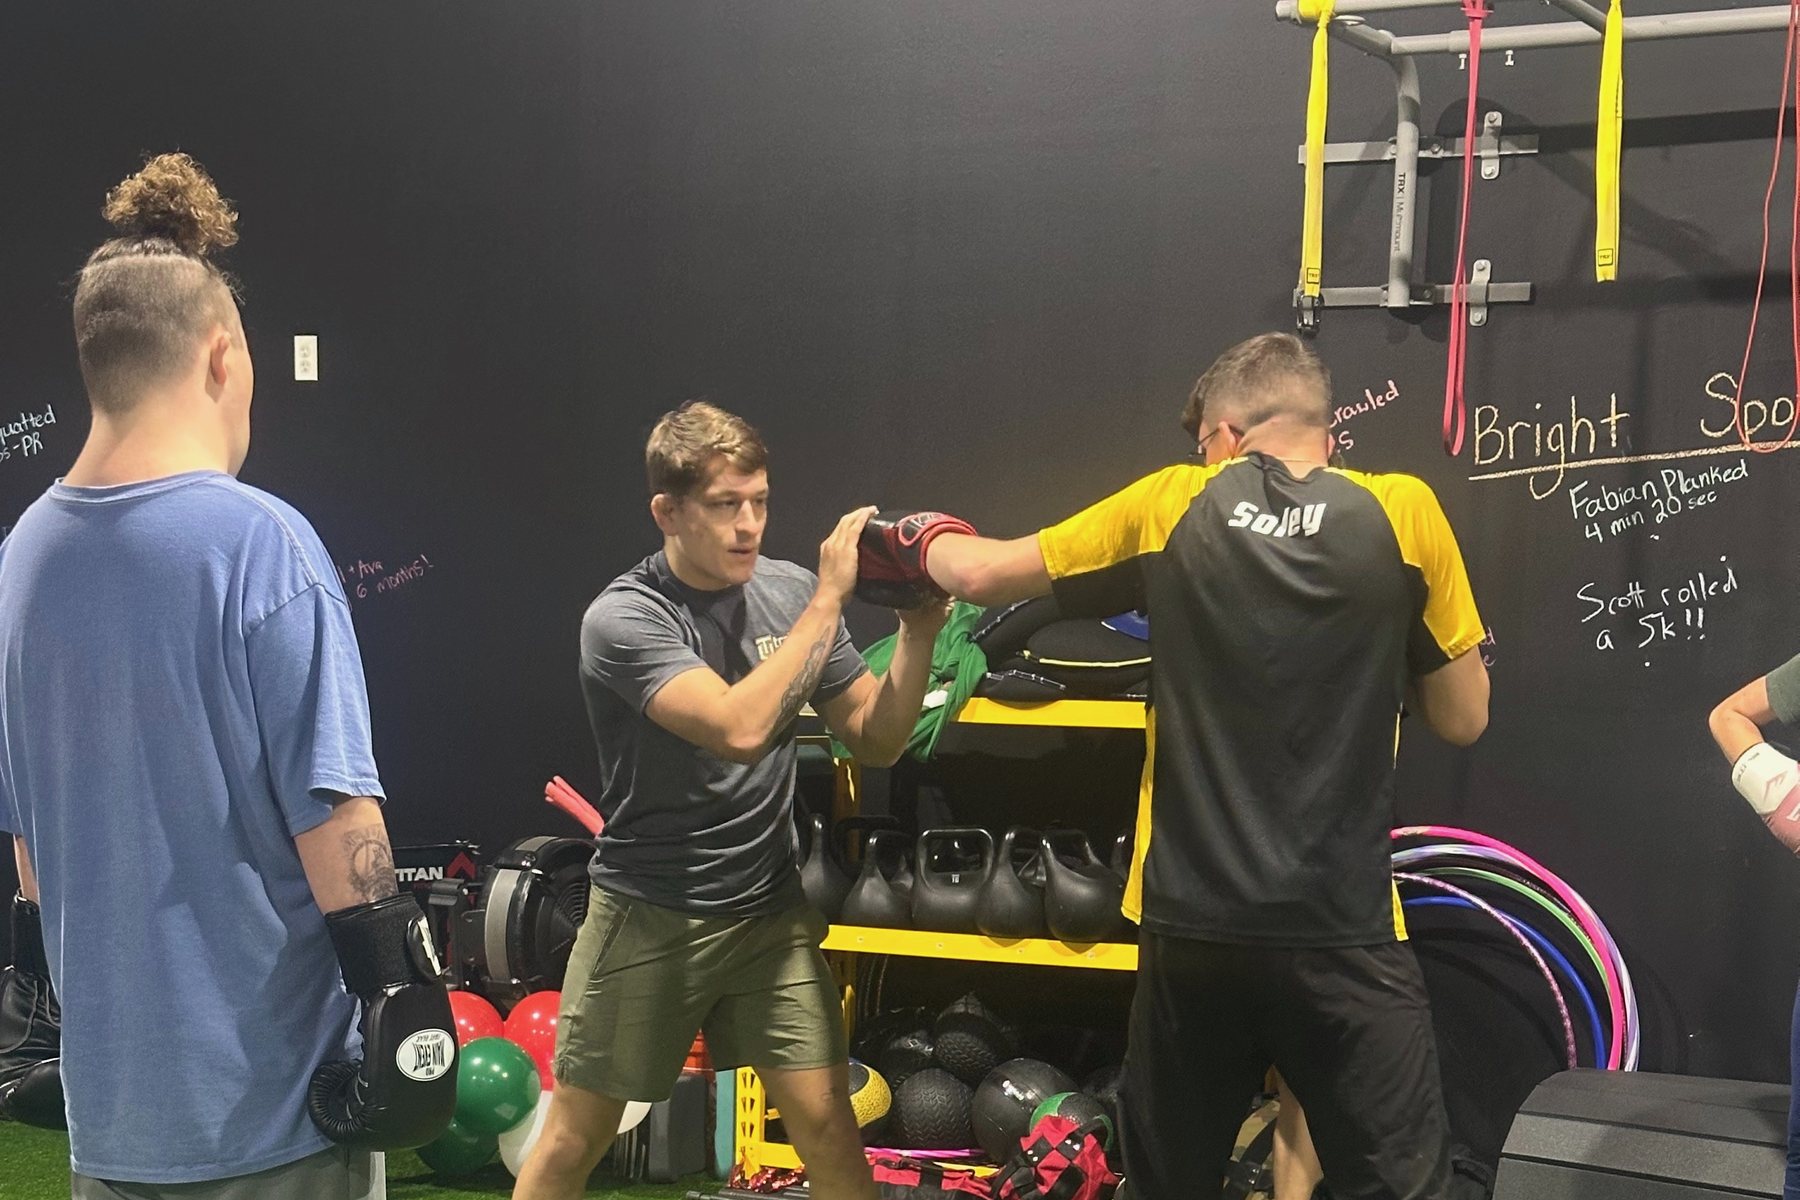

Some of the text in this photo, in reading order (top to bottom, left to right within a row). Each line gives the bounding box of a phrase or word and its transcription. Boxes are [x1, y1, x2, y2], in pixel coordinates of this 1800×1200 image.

[1475, 393, 1630, 500] Bright
[1569, 458, 1749, 520] Fabian Planked
[1227, 500, 1328, 539] Soley
[1584, 490, 1718, 543] 4 min 20 sec
[356, 583, 368, 599] 6
[1576, 567, 1739, 623] Scott rolled
[1595, 628, 1615, 650] a
[395, 866, 444, 882] ITAN
